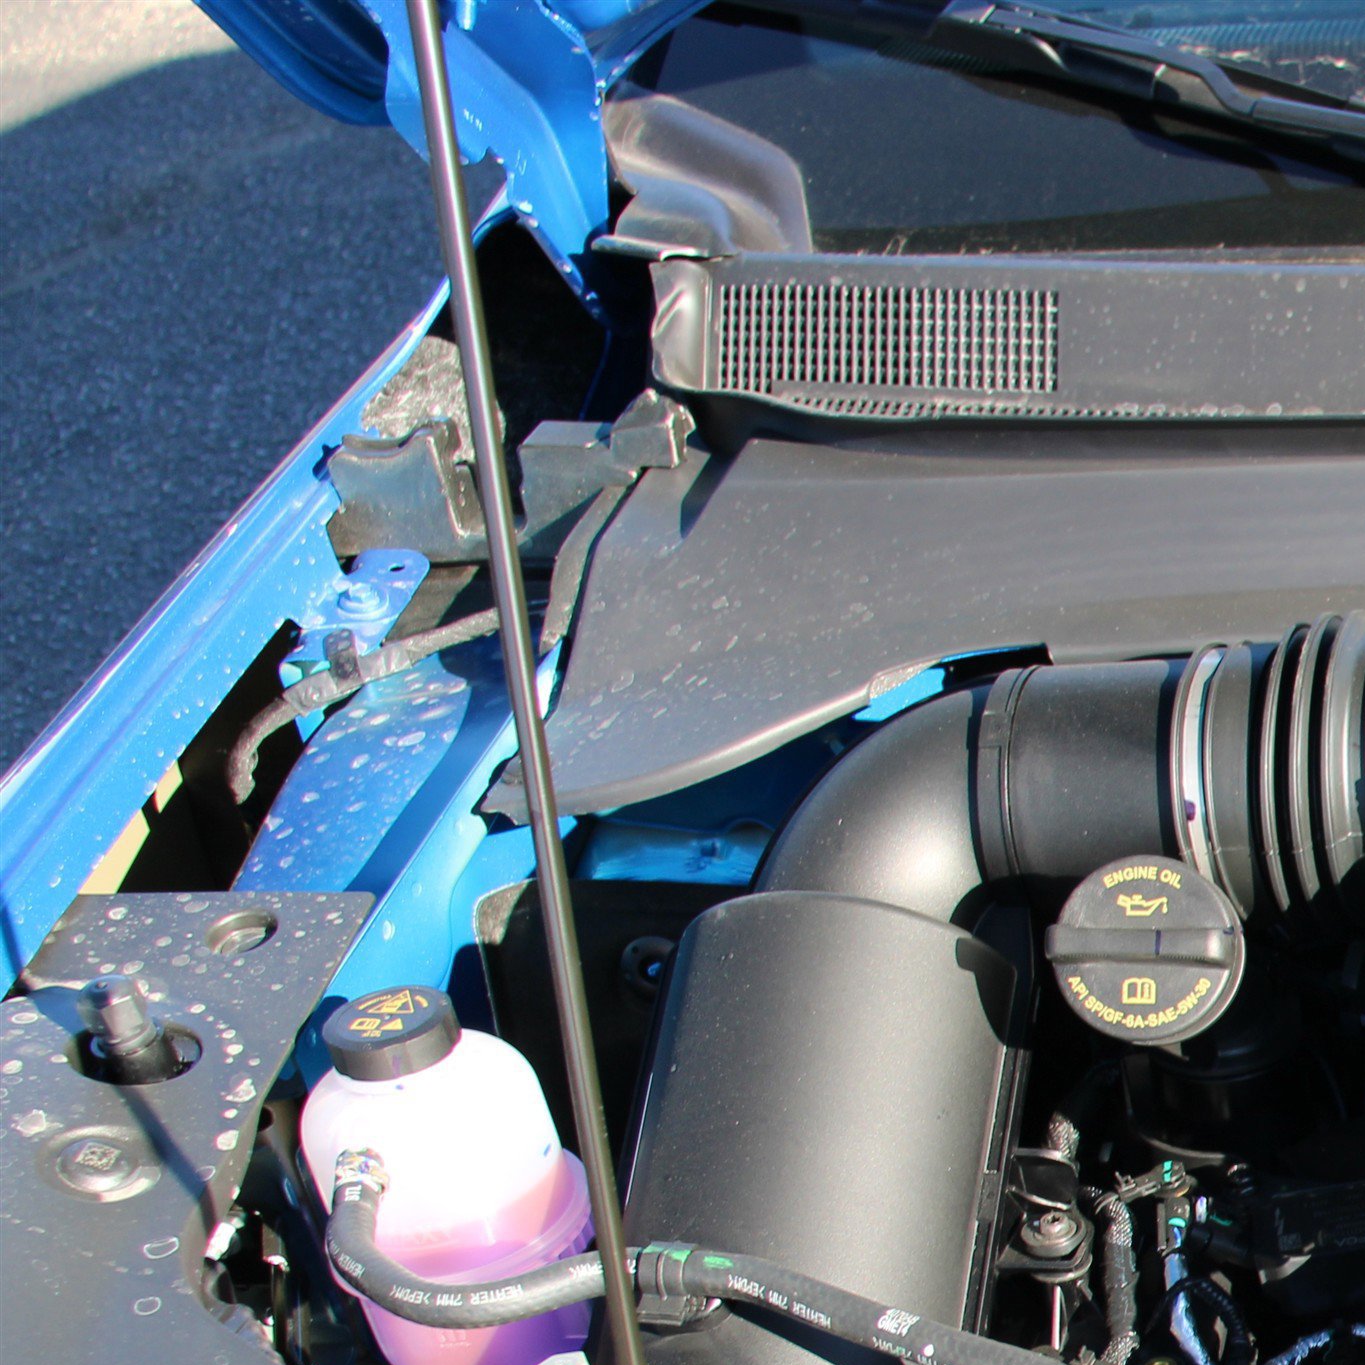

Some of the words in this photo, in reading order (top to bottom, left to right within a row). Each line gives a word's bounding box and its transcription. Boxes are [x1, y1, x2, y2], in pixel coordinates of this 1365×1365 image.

[1103, 866, 1158, 889] ENGINE
[1159, 869, 1183, 890] OIL
[1067, 975, 1090, 1000] API
[436, 1293, 462, 1307] 7MM
[469, 1283, 523, 1306] HEATER
[792, 1301, 832, 1329] HEATER
